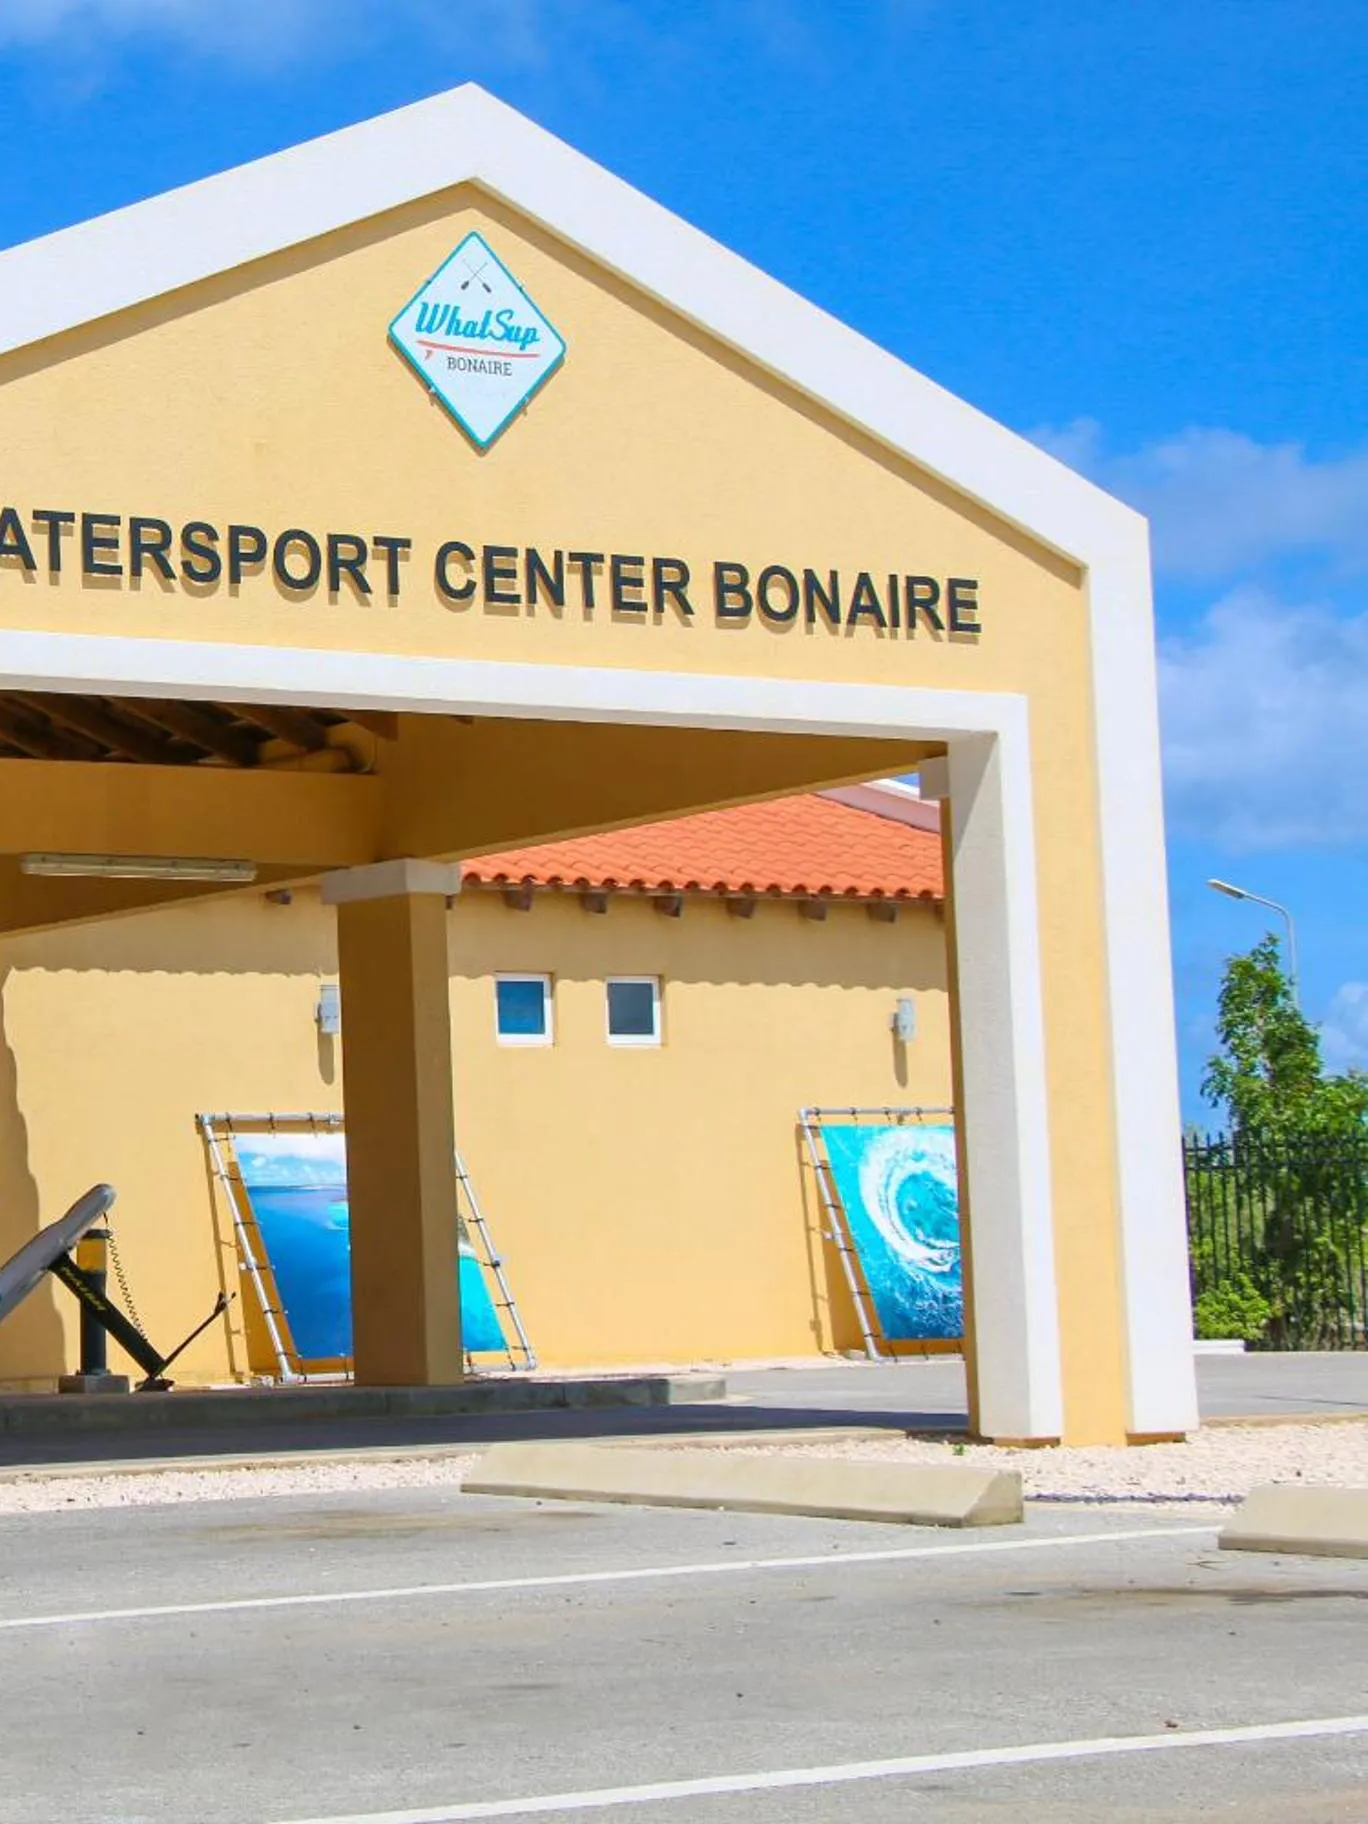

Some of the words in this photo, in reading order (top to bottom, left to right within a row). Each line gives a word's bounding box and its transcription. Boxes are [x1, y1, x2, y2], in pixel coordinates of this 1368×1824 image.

[447, 356, 512, 376] BONAIRE
[434, 540, 694, 616] CENTER
[713, 560, 982, 633] BONAIRE
